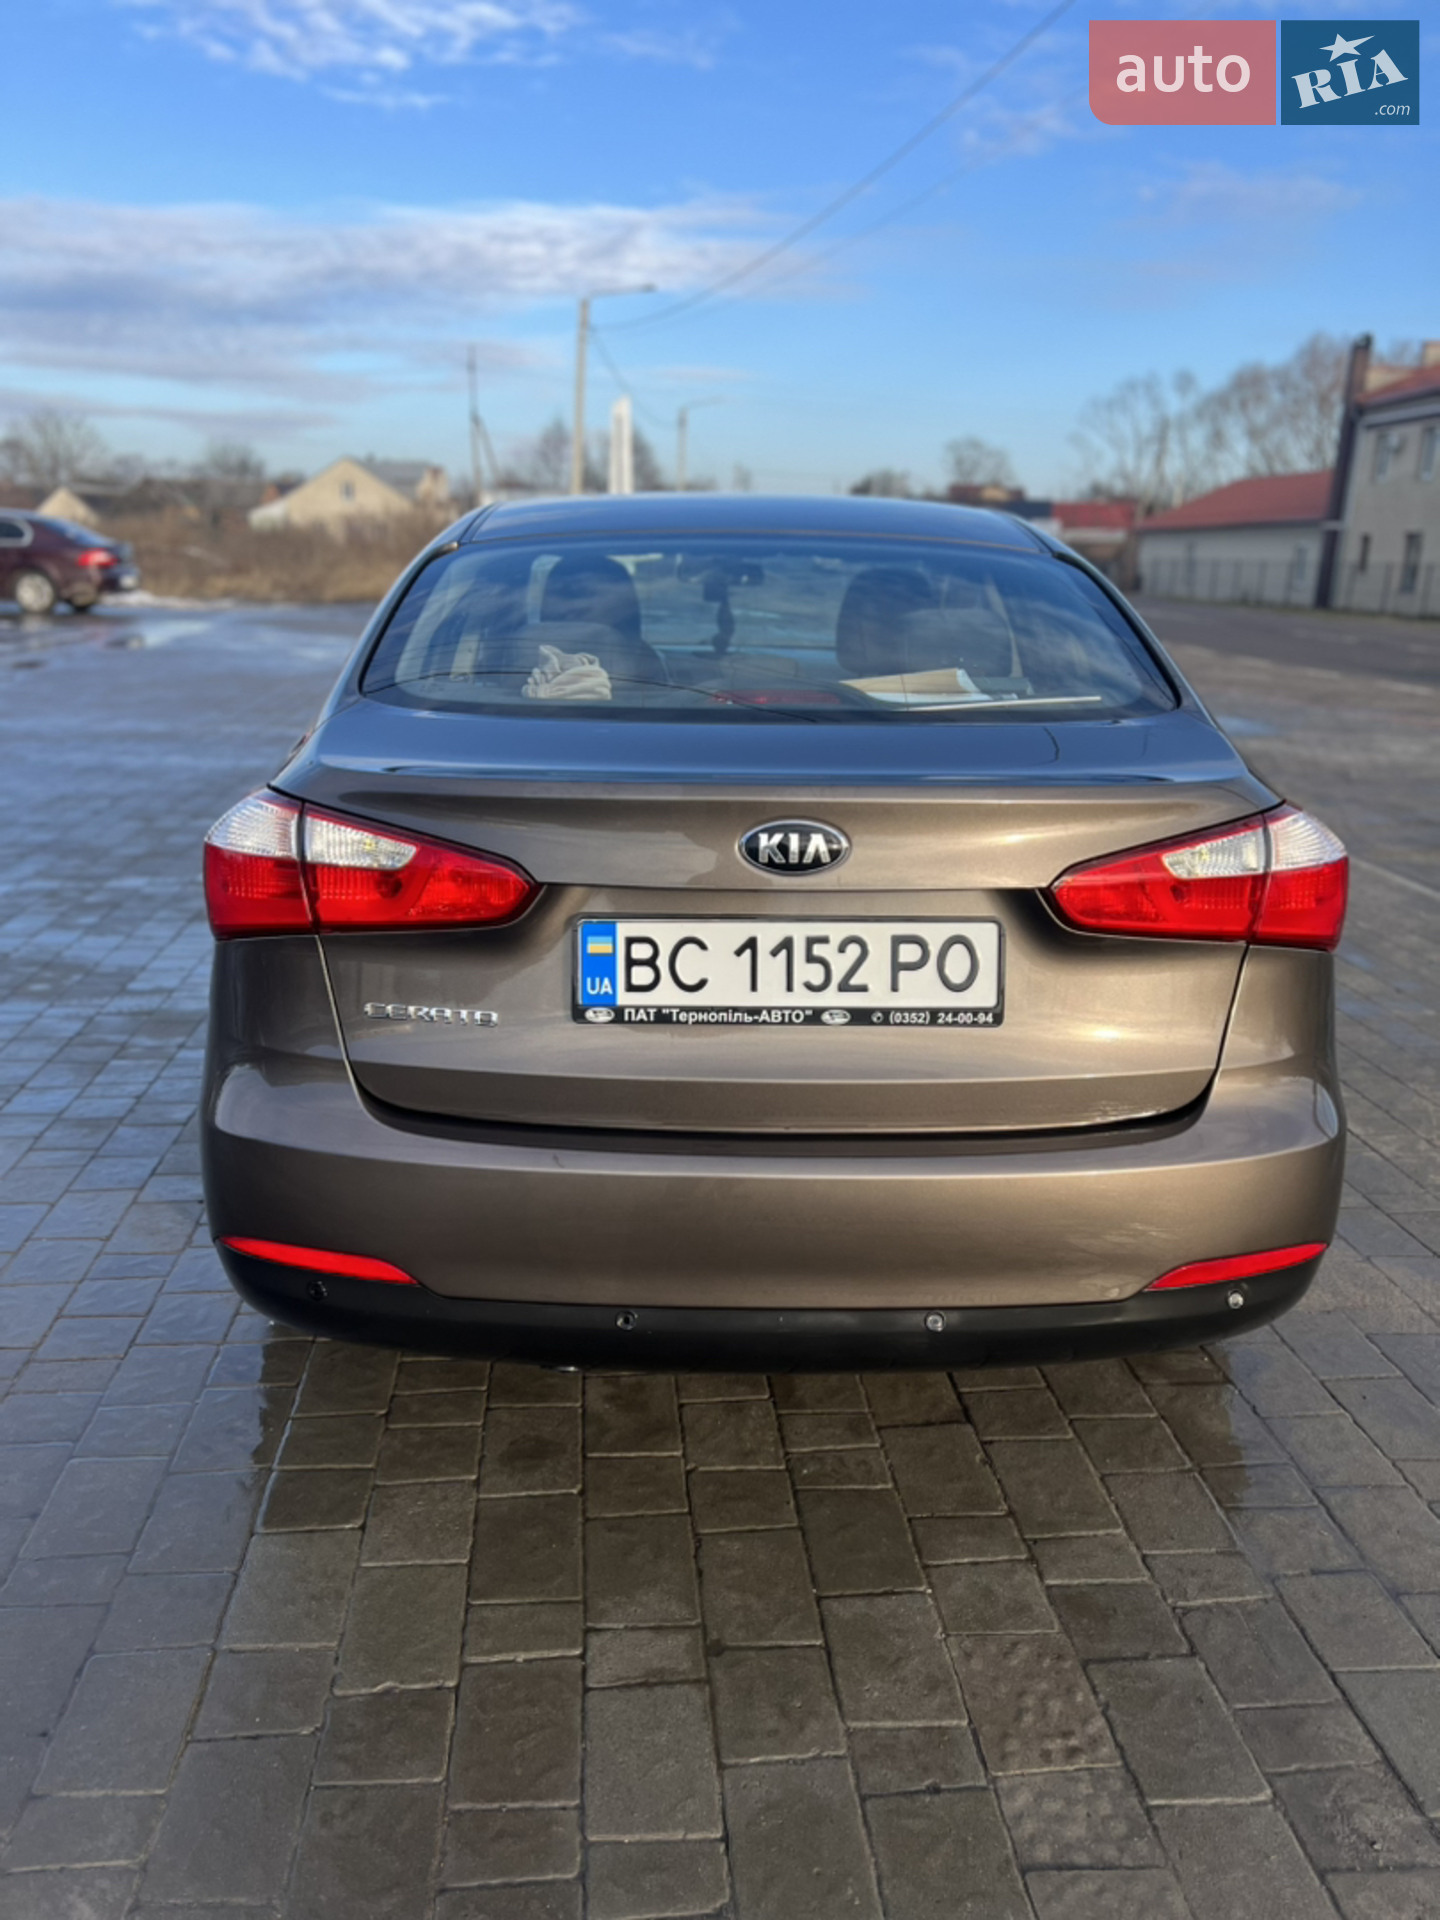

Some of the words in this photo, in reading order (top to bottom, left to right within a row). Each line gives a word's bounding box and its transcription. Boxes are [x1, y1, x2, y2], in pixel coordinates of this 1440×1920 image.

[758, 833, 831, 863] KIA
[624, 936, 709, 993] BC
[733, 935, 869, 993] 1152
[890, 934, 980, 993] PO
[586, 977, 613, 995] UA
[364, 1002, 498, 1027] CERATO
[624, 1008, 657, 1022] ПАТ
[889, 1010, 930, 1025] (0352)
[936, 1012, 994, 1024] 24-00-94
